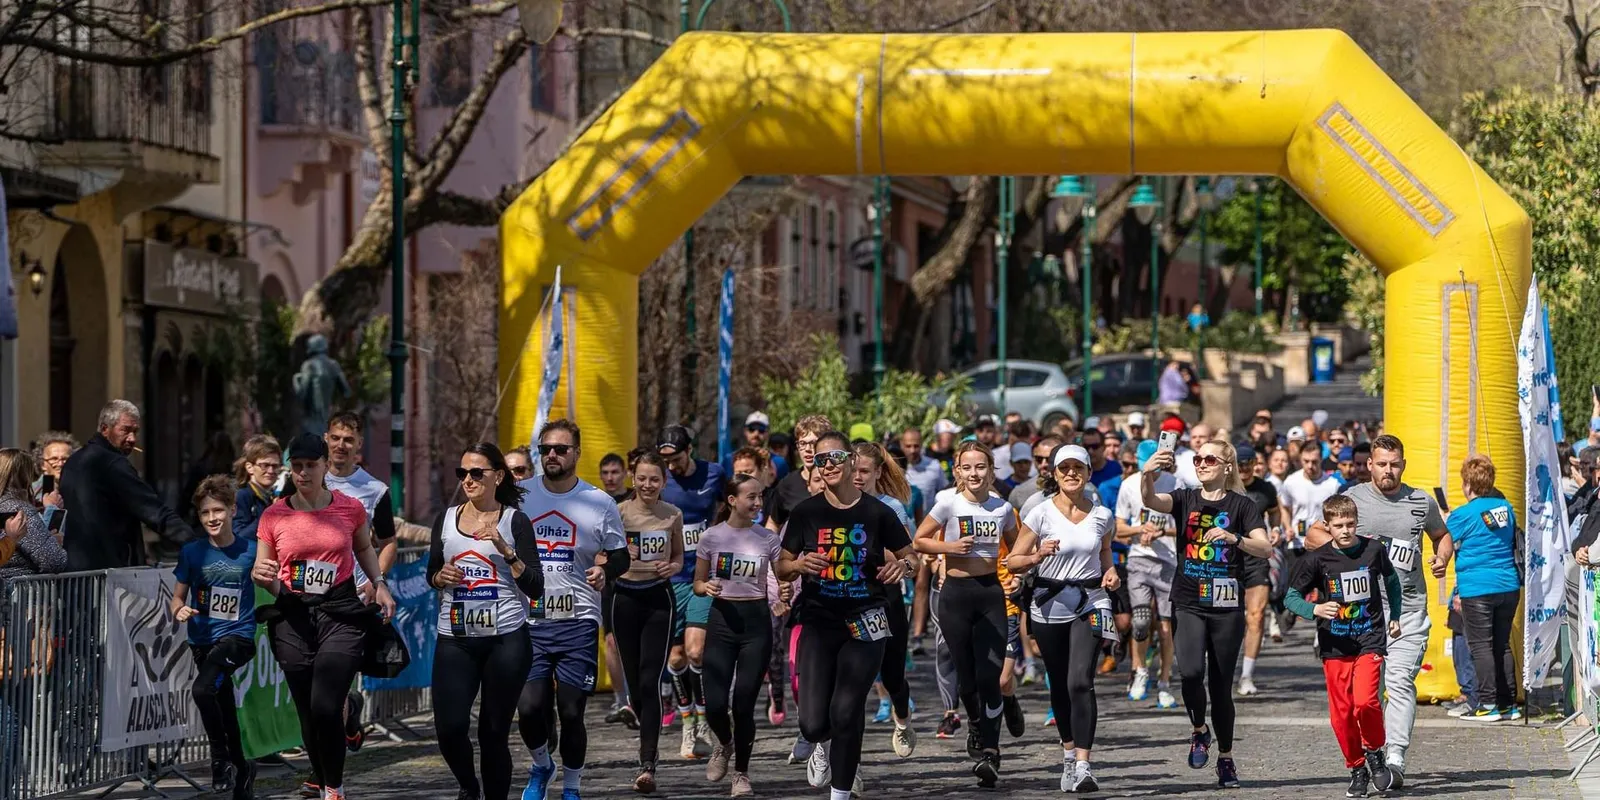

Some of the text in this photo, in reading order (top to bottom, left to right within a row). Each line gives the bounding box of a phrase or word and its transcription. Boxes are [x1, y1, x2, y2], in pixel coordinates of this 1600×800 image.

[975, 521, 998, 537] 632
[1187, 511, 1230, 529] ESŐ
[536, 525, 569, 538] Újház
[817, 524, 867, 545] ESŐ
[642, 537, 665, 555] 532
[1186, 543, 1229, 563] NÓK
[1390, 544, 1415, 564] 707
[306, 566, 334, 588] 344
[733, 559, 756, 577] 271
[1215, 584, 1237, 601] 711
[1344, 576, 1368, 596] 700
[211, 593, 238, 614] 282
[546, 594, 573, 613] 440
[465, 608, 495, 629] 441
[126, 689, 191, 733] ALISCA BAU
